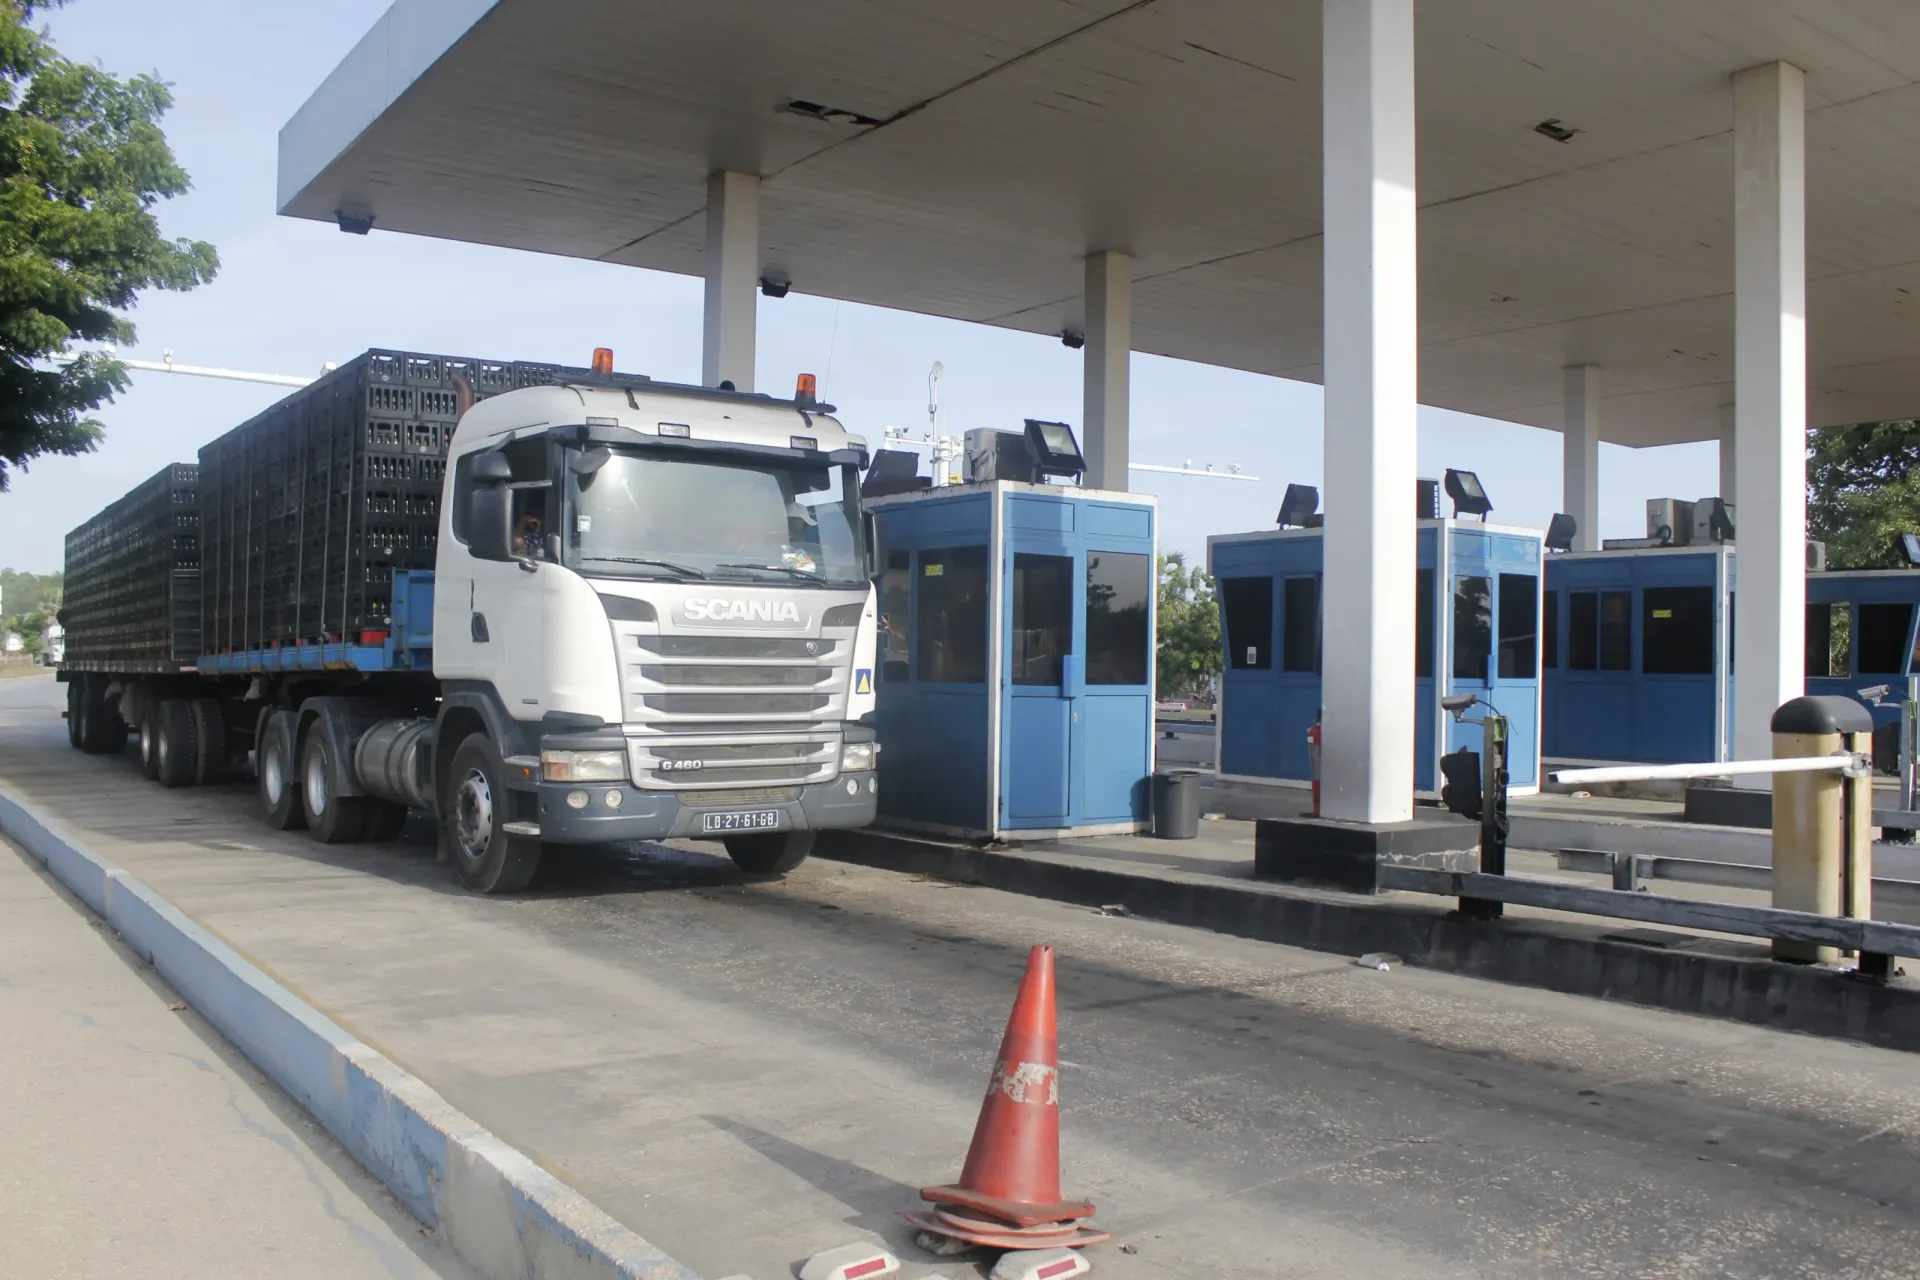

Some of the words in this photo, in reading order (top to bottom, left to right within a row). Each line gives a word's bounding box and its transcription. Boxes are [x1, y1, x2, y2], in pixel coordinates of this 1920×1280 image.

[683, 598, 800, 622] SCANIA
[662, 760, 672, 770] G
[674, 760, 702, 769] 460
